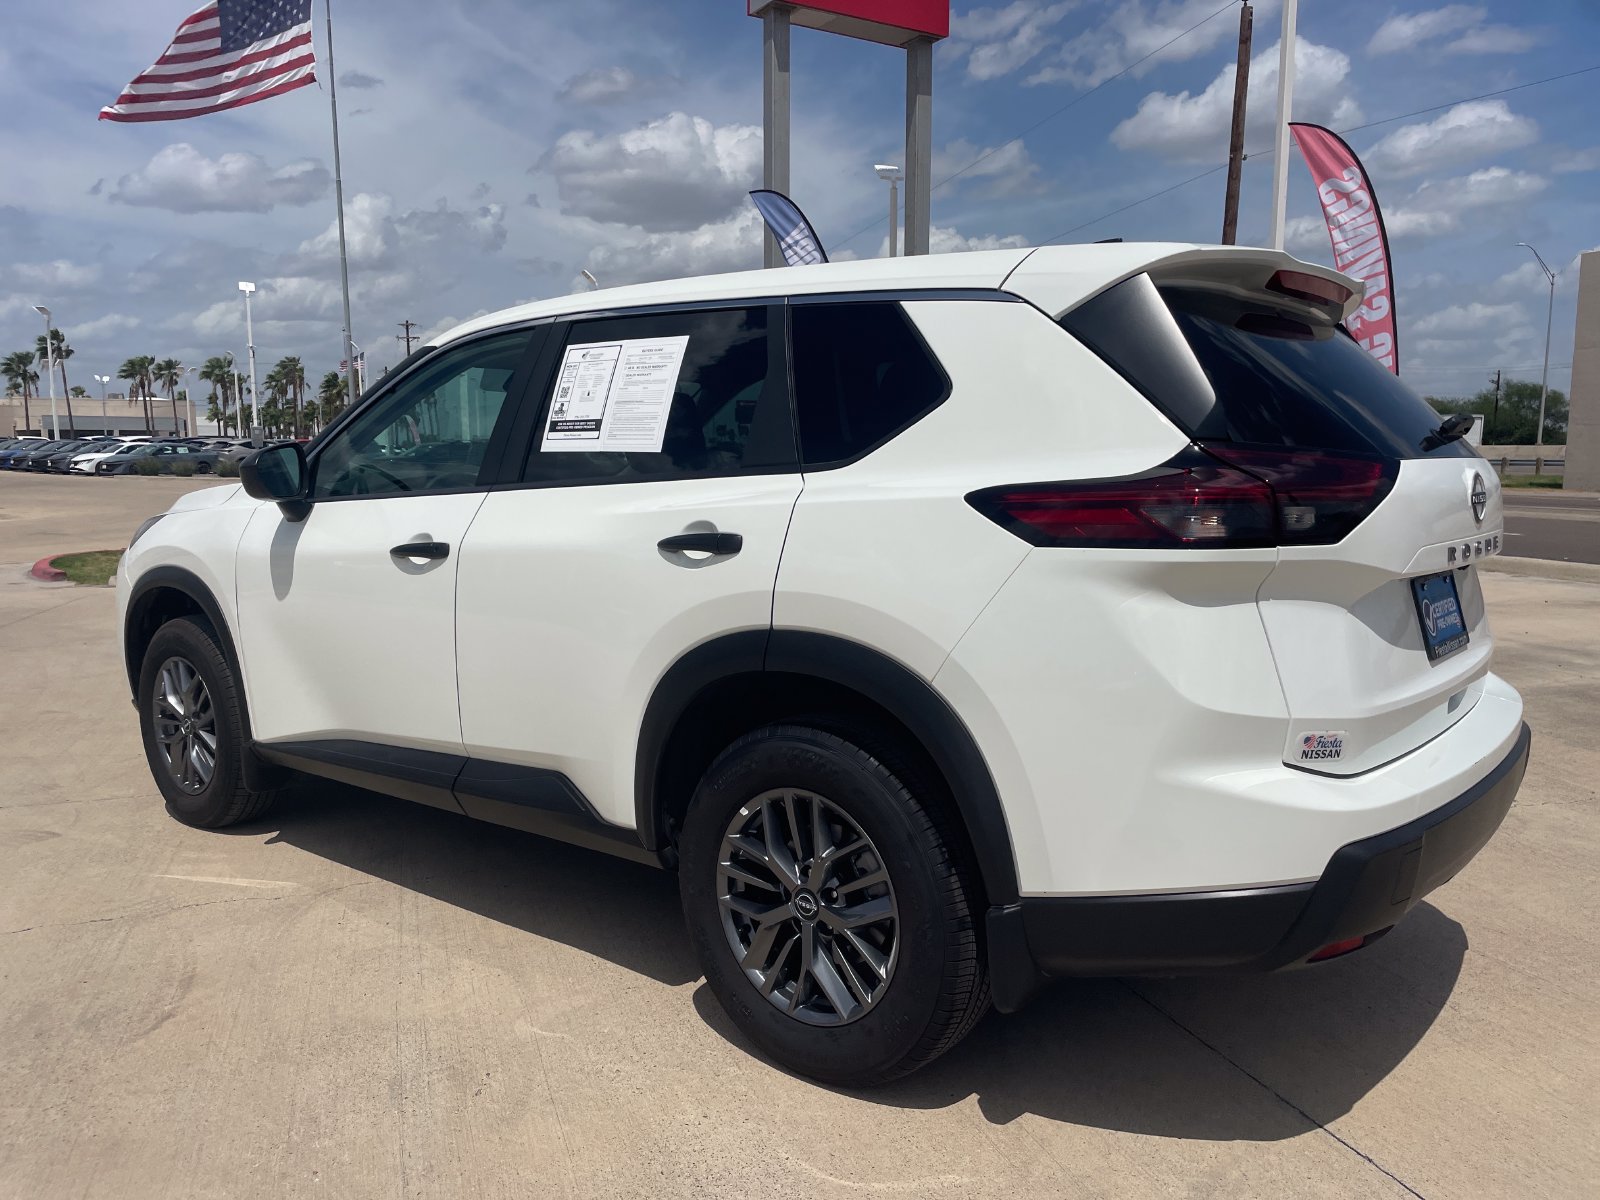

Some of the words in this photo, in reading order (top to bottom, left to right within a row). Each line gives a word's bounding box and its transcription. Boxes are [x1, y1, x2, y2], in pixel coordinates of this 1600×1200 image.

[1447, 535, 1499, 563] ROGUE
[1313, 735, 1343, 749] Fiesta
[1300, 749, 1341, 760] NISSAN
